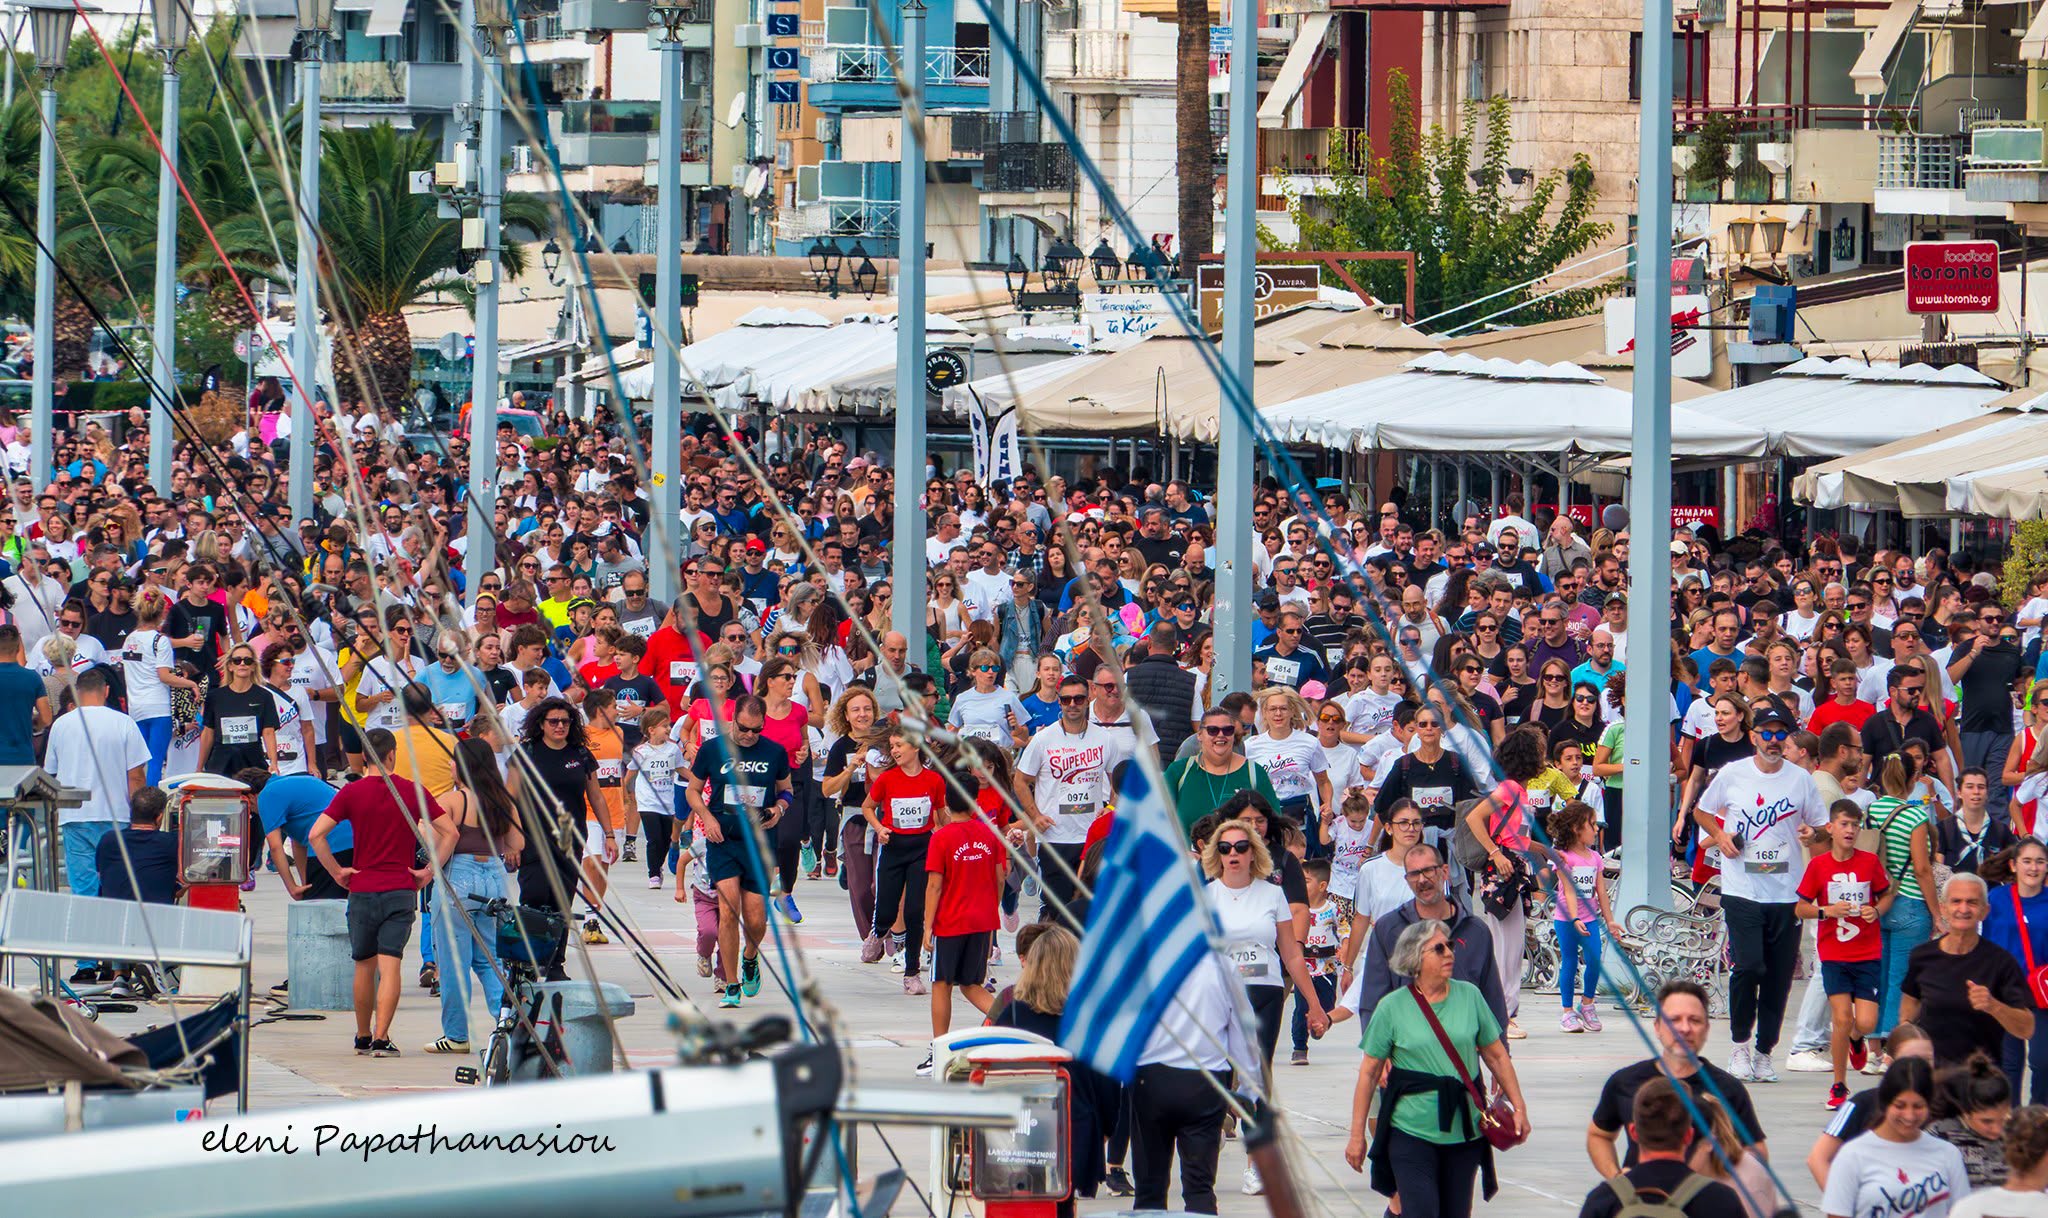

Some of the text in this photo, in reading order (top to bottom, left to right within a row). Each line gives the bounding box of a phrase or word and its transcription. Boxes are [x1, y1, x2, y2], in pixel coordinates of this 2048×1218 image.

[1943, 249, 1994, 263] foodbar
[1911, 263, 1994, 280] toronto
[1915, 294, 1992, 306] www.toronto.gr
[927, 355, 963, 378] FRANKLIN
[678, 668, 696, 676] 0074
[1273, 664, 1292, 674] 4814
[229, 724, 249, 733] 3339
[650, 760, 669, 768] 2701
[1049, 745, 1104, 779] SUPERDRY
[600, 767, 619, 776] 0234
[1067, 792, 1089, 802] 0974
[899, 806, 922, 816] 2661
[1755, 850, 1779, 860] 1687
[1573, 876, 1593, 884] 3490
[1839, 892, 1864, 902] 4219
